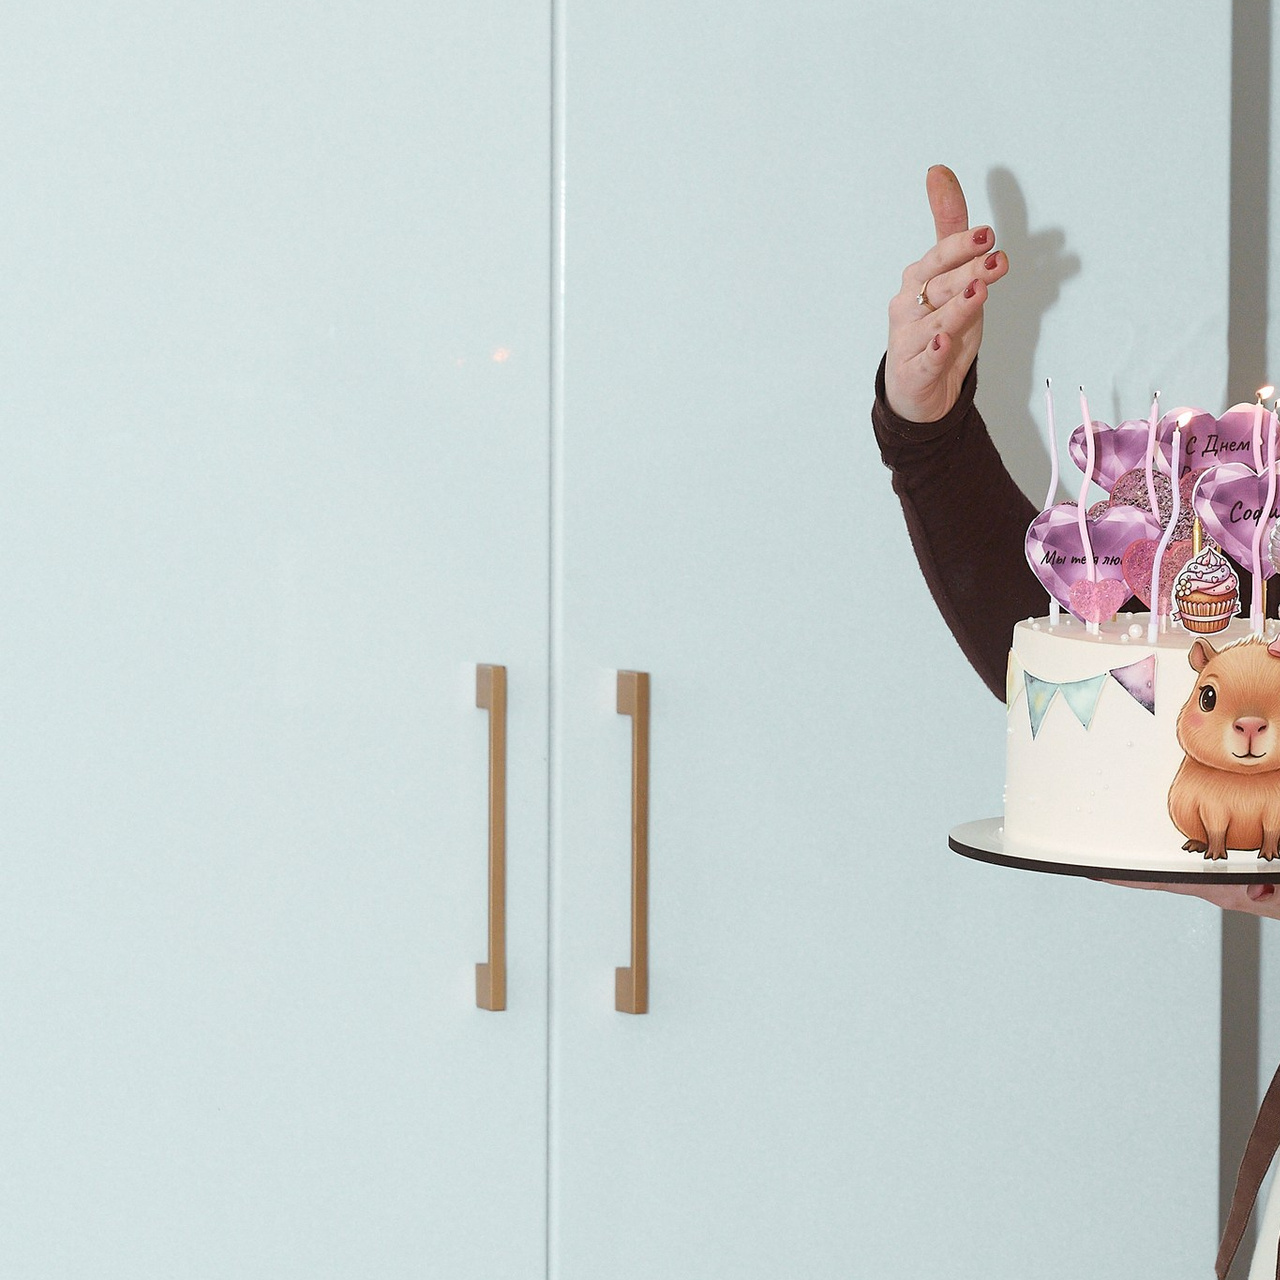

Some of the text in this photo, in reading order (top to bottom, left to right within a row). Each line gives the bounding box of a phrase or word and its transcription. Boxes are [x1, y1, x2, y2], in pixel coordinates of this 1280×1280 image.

[1185, 433, 1251, 458] С Днем
[1040, 549, 1067, 566] Мы
[1070, 554, 1099, 566] тея
